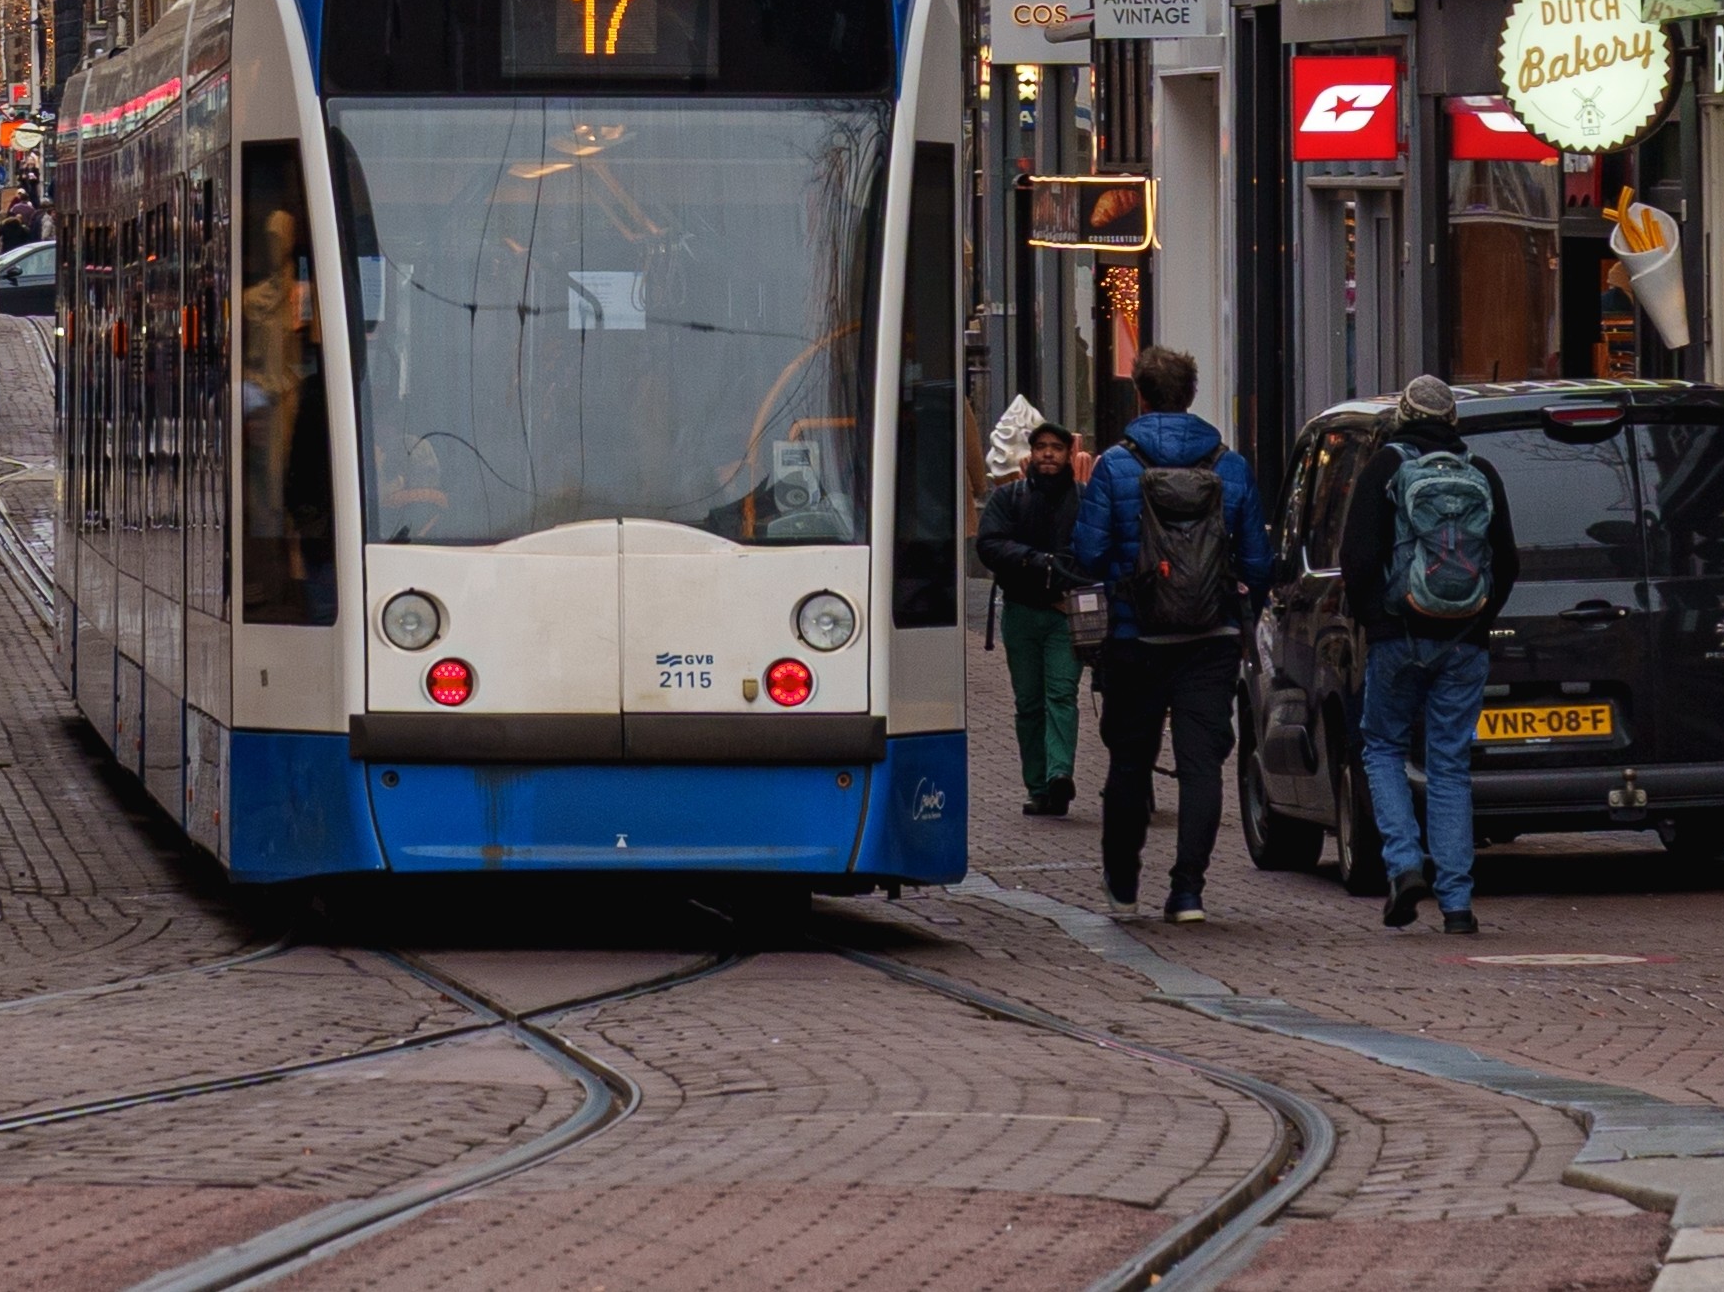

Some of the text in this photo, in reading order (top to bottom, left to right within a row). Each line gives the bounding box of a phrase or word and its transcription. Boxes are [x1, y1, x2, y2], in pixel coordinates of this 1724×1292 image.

[1014, 5, 1069, 24] COS
[1113, 7, 1190, 25] VINTAGE
[1518, 29, 1655, 94] Bakery
[684, 654, 714, 665] GVB
[659, 670, 712, 688] 2115
[1483, 709, 1605, 734] VNR-08-F
